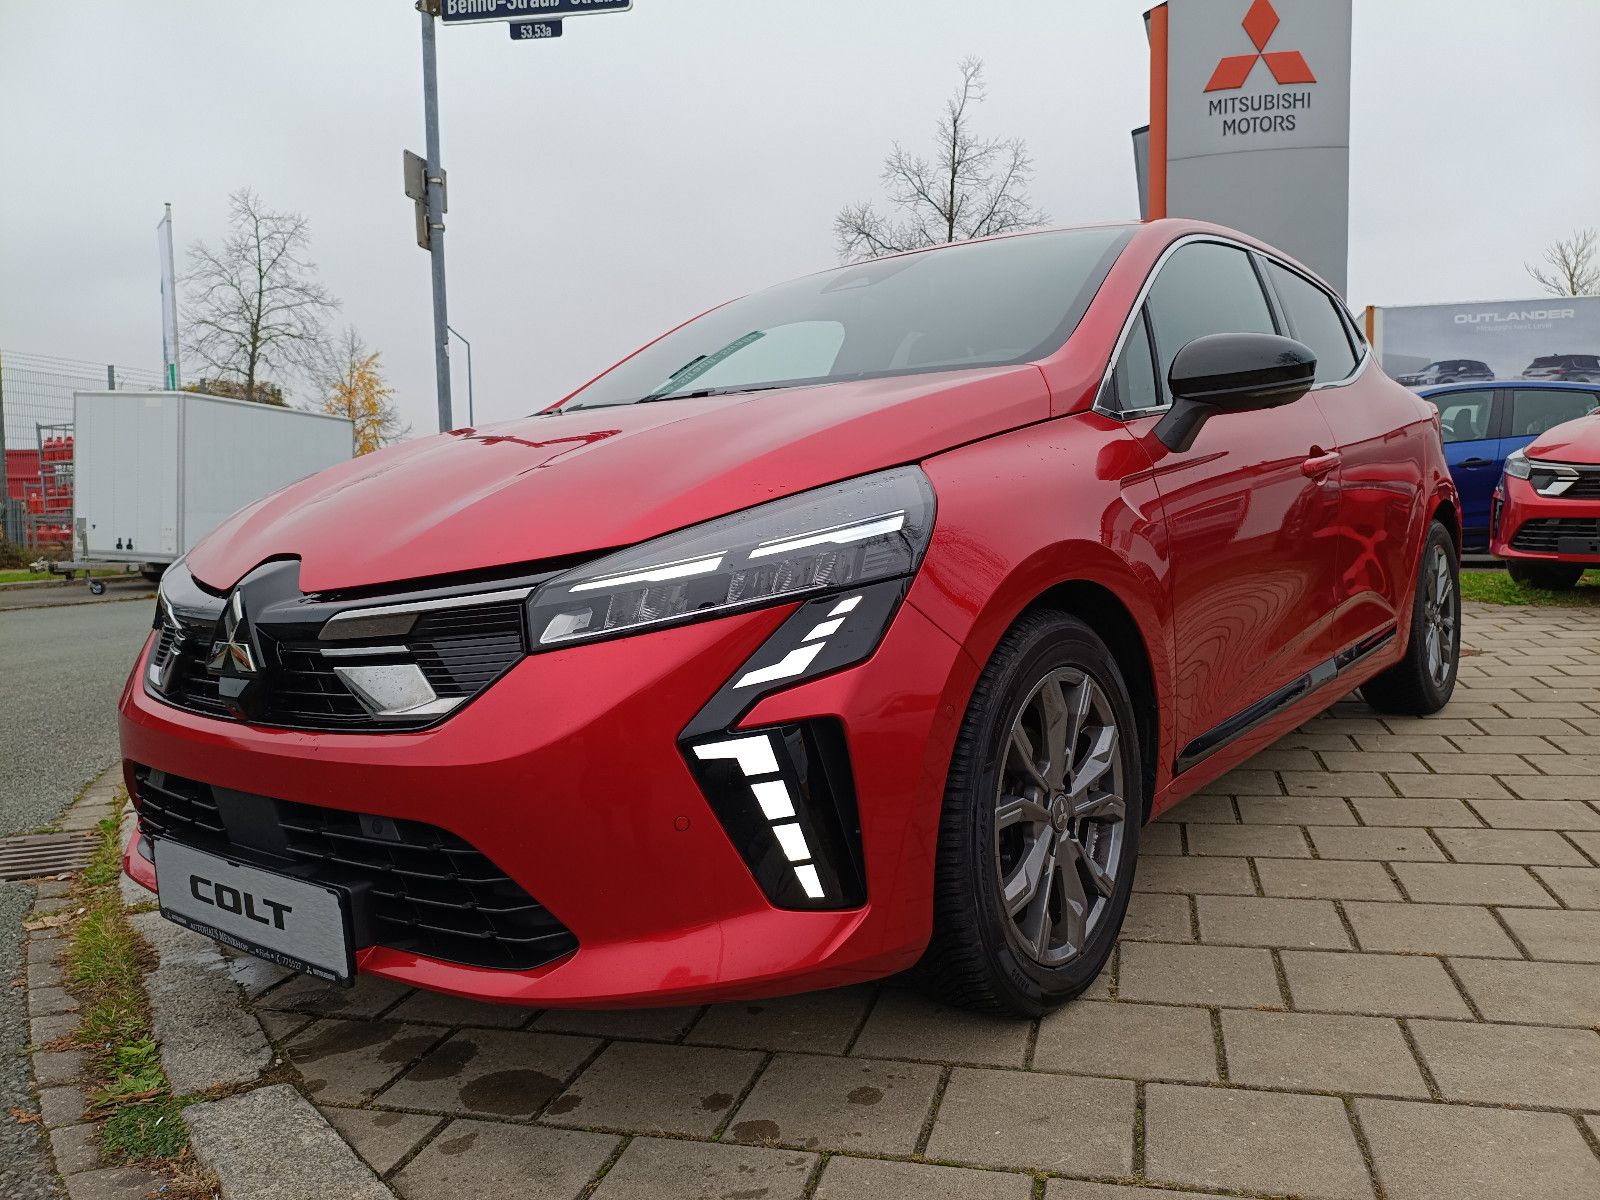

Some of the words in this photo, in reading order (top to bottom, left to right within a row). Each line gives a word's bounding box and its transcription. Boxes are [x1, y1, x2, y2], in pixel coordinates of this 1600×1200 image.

[520, 24, 552, 39] 53,53a
[1208, 92, 1311, 116] MITSUBISHI
[1222, 114, 1296, 136] MOTORS
[1454, 308, 1575, 324] OUTLANDER
[189, 874, 292, 931] COLT
